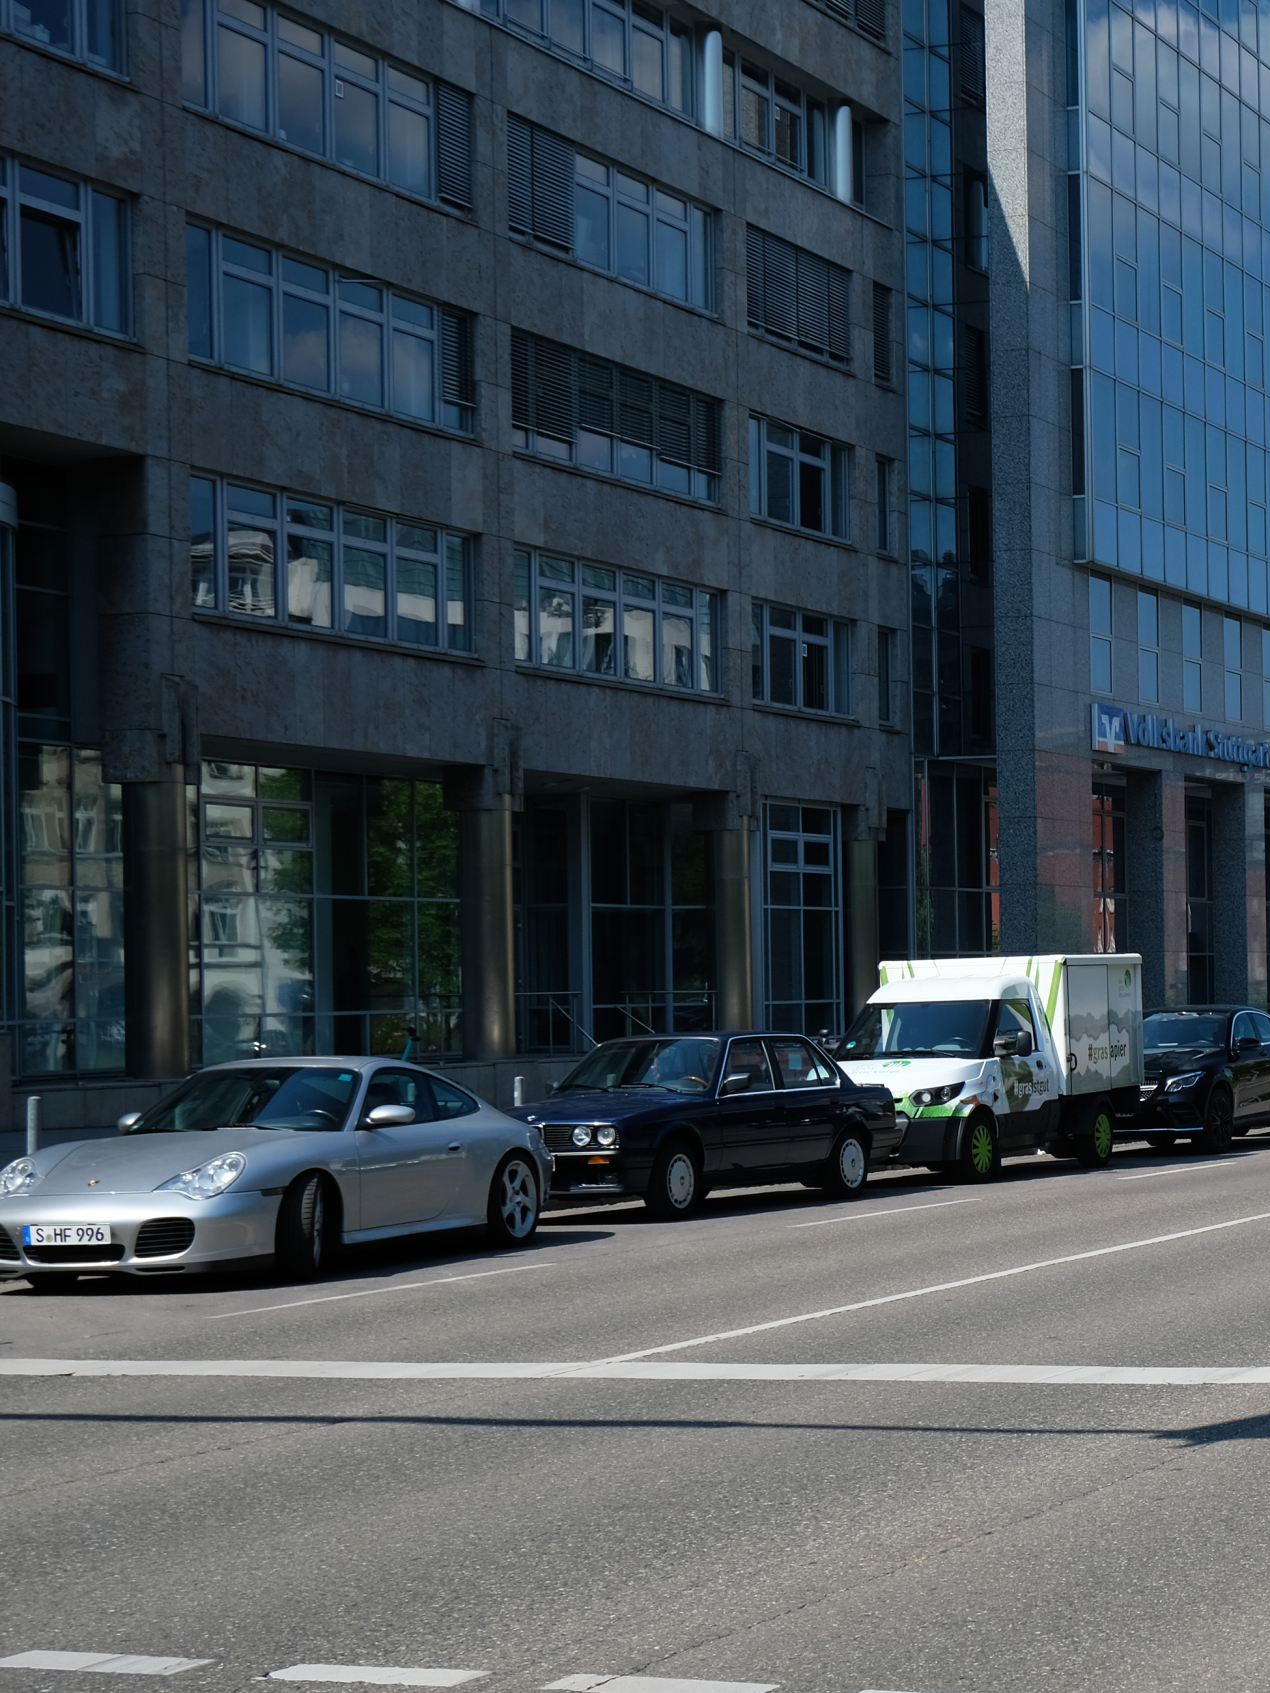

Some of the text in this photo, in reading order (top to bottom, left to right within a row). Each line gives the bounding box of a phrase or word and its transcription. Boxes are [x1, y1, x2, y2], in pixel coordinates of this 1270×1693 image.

[1124, 712, 1208, 756] Volksbank
[1087, 1039, 1127, 1065] #grasapier
[36, 1228, 45, 1242] S
[53, 1228, 72, 1242] HF
[76, 1227, 104, 1242] 996
